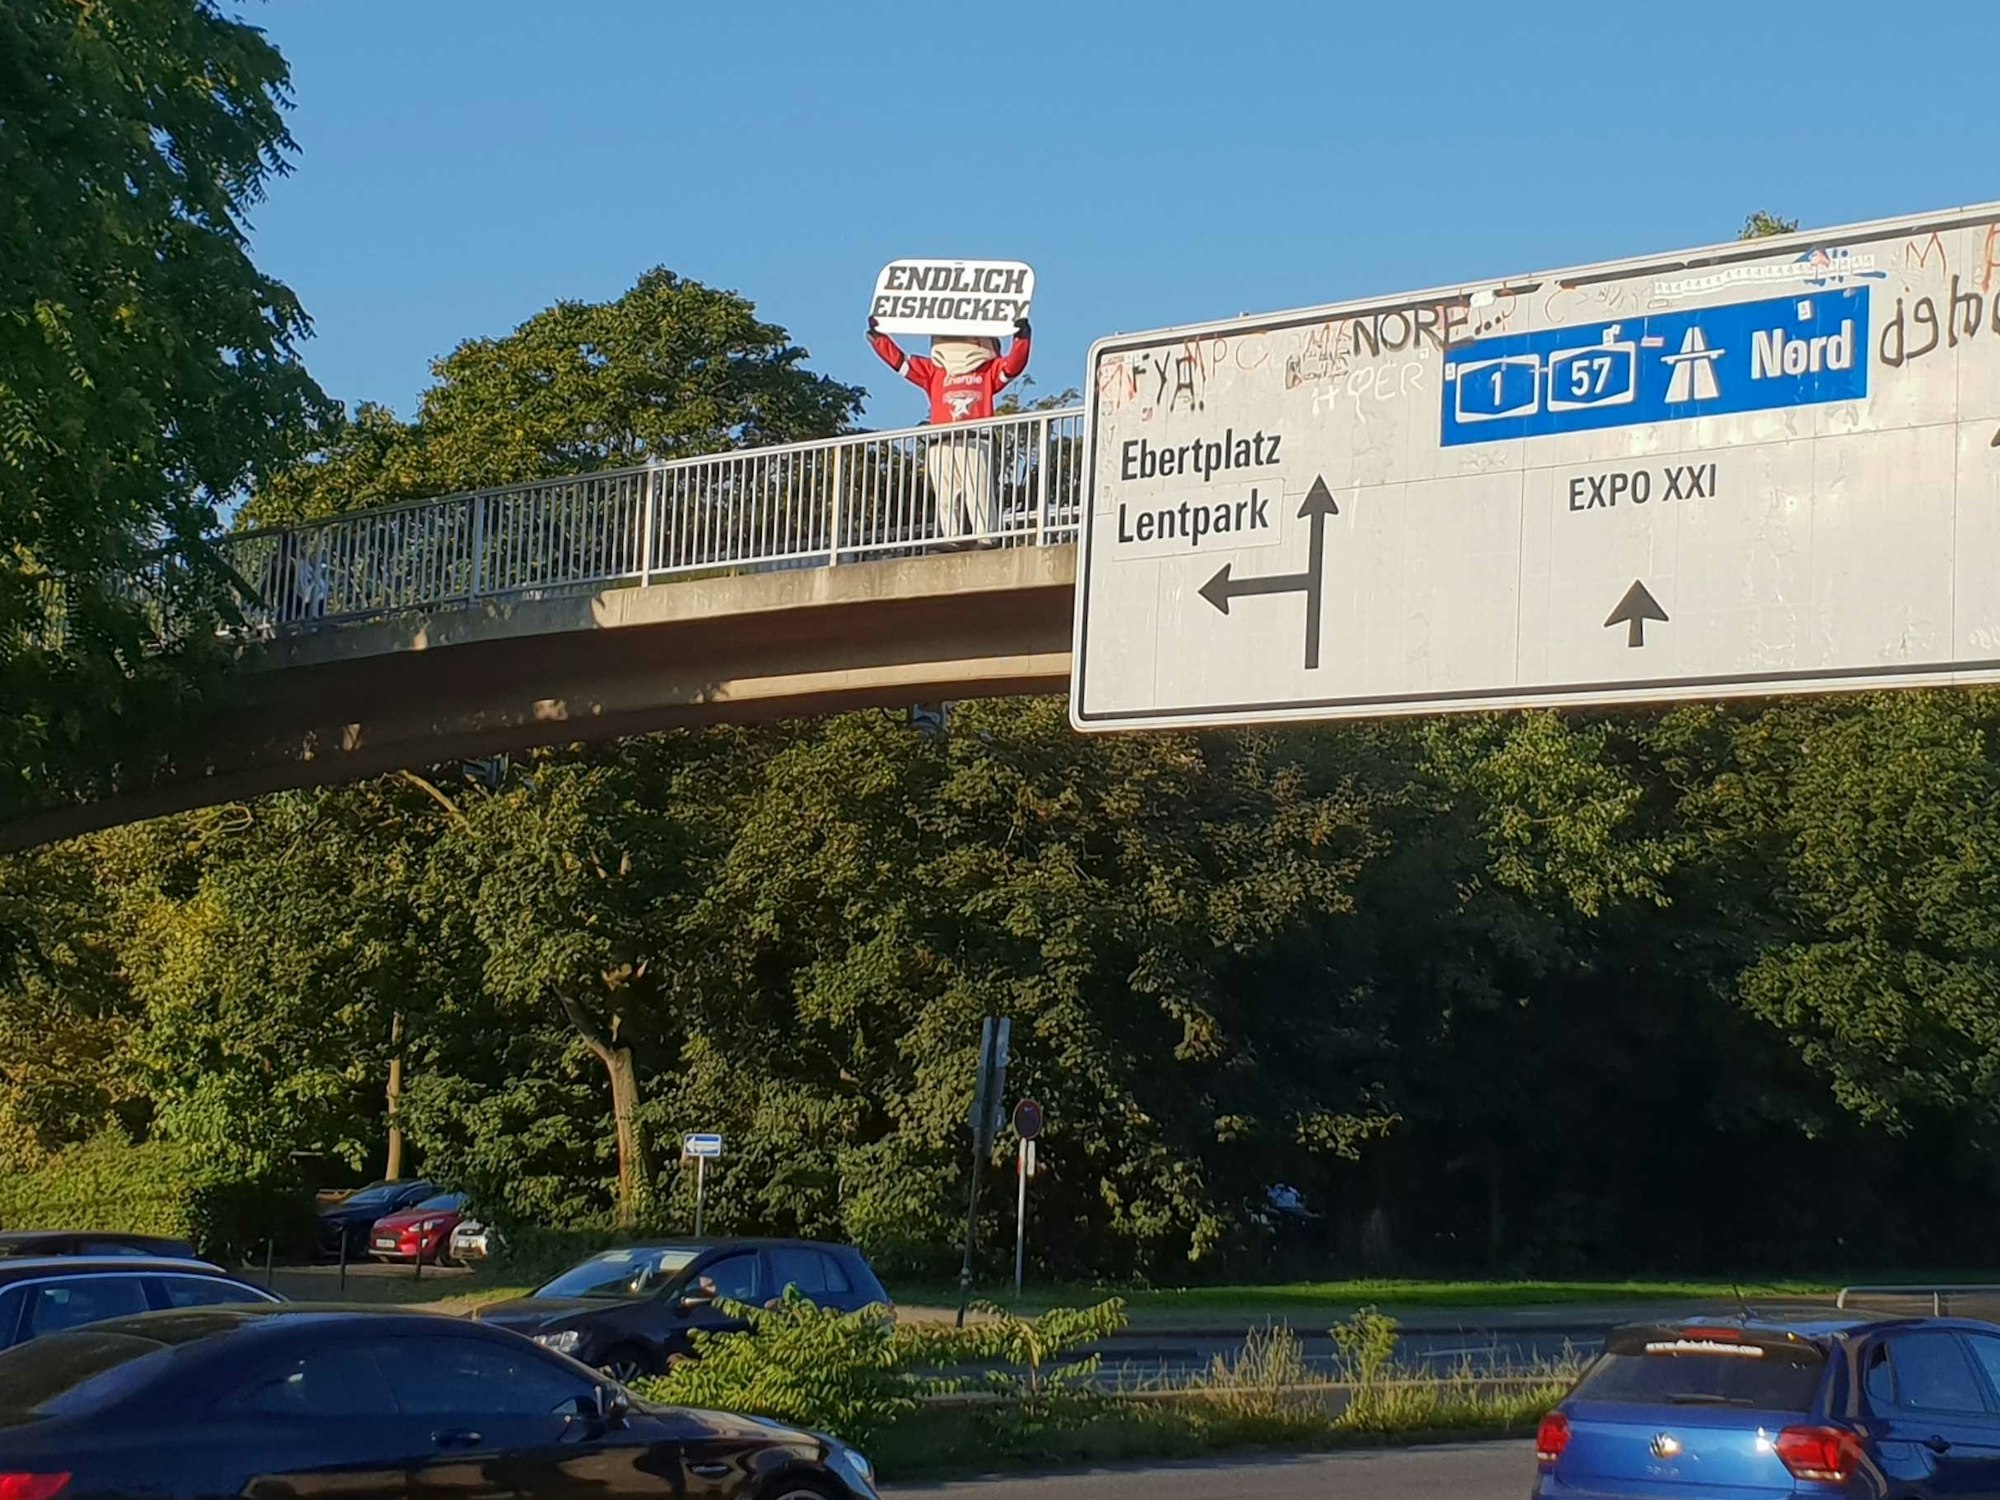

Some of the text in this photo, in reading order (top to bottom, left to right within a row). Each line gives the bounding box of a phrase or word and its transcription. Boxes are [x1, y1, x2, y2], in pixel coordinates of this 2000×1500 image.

[884, 266, 1028, 294] ENDLICH
[873, 296, 1030, 322] EISHOCKEY
[1490, 319, 1852, 406] 1 57 Nord
[1121, 428, 1281, 482] Ebertplatz
[1569, 464, 1716, 512] EXPO XXI
[1118, 488, 1270, 546] Lentpark
